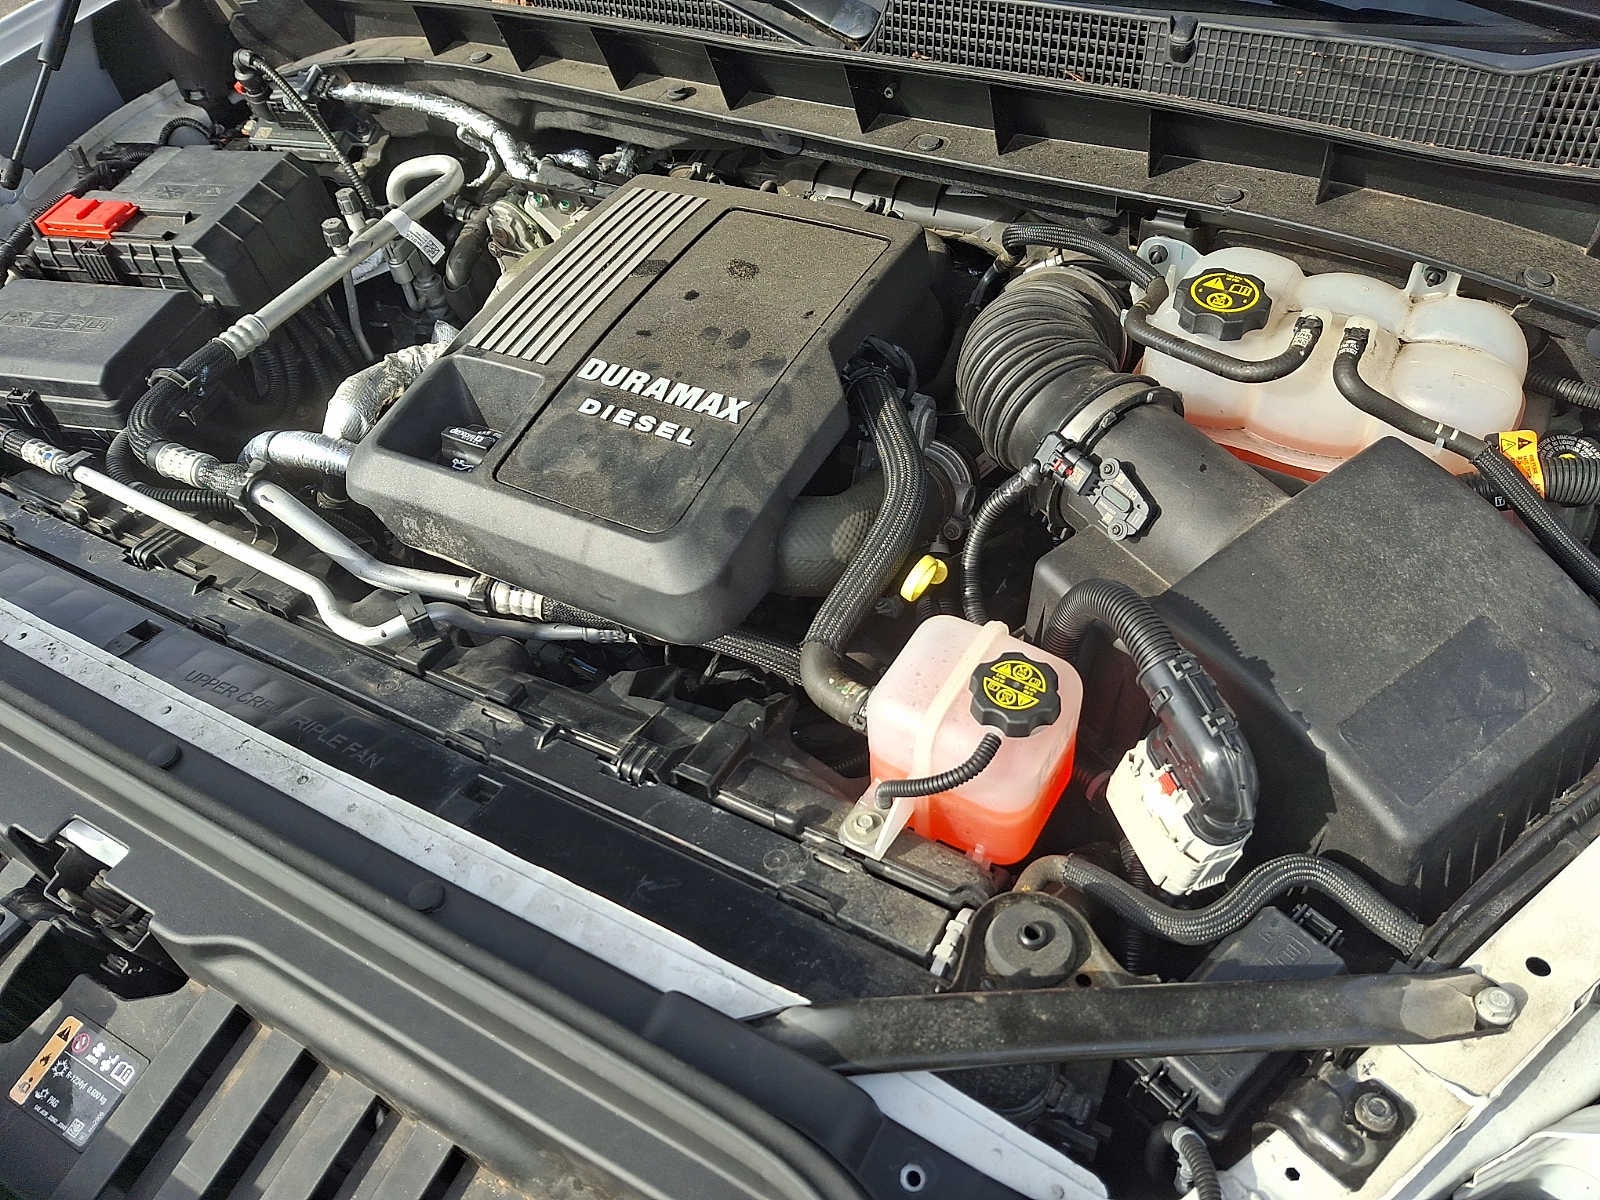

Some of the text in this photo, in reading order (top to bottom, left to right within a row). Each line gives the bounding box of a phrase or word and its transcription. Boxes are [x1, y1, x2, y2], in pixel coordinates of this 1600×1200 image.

[576, 357, 753, 424] DURAMAX
[577, 397, 696, 447] DIESEL
[184, 670, 239, 698] UPPER
[292, 717, 384, 769] RIPLE FAN
[47, 1095, 60, 1108] PAG
